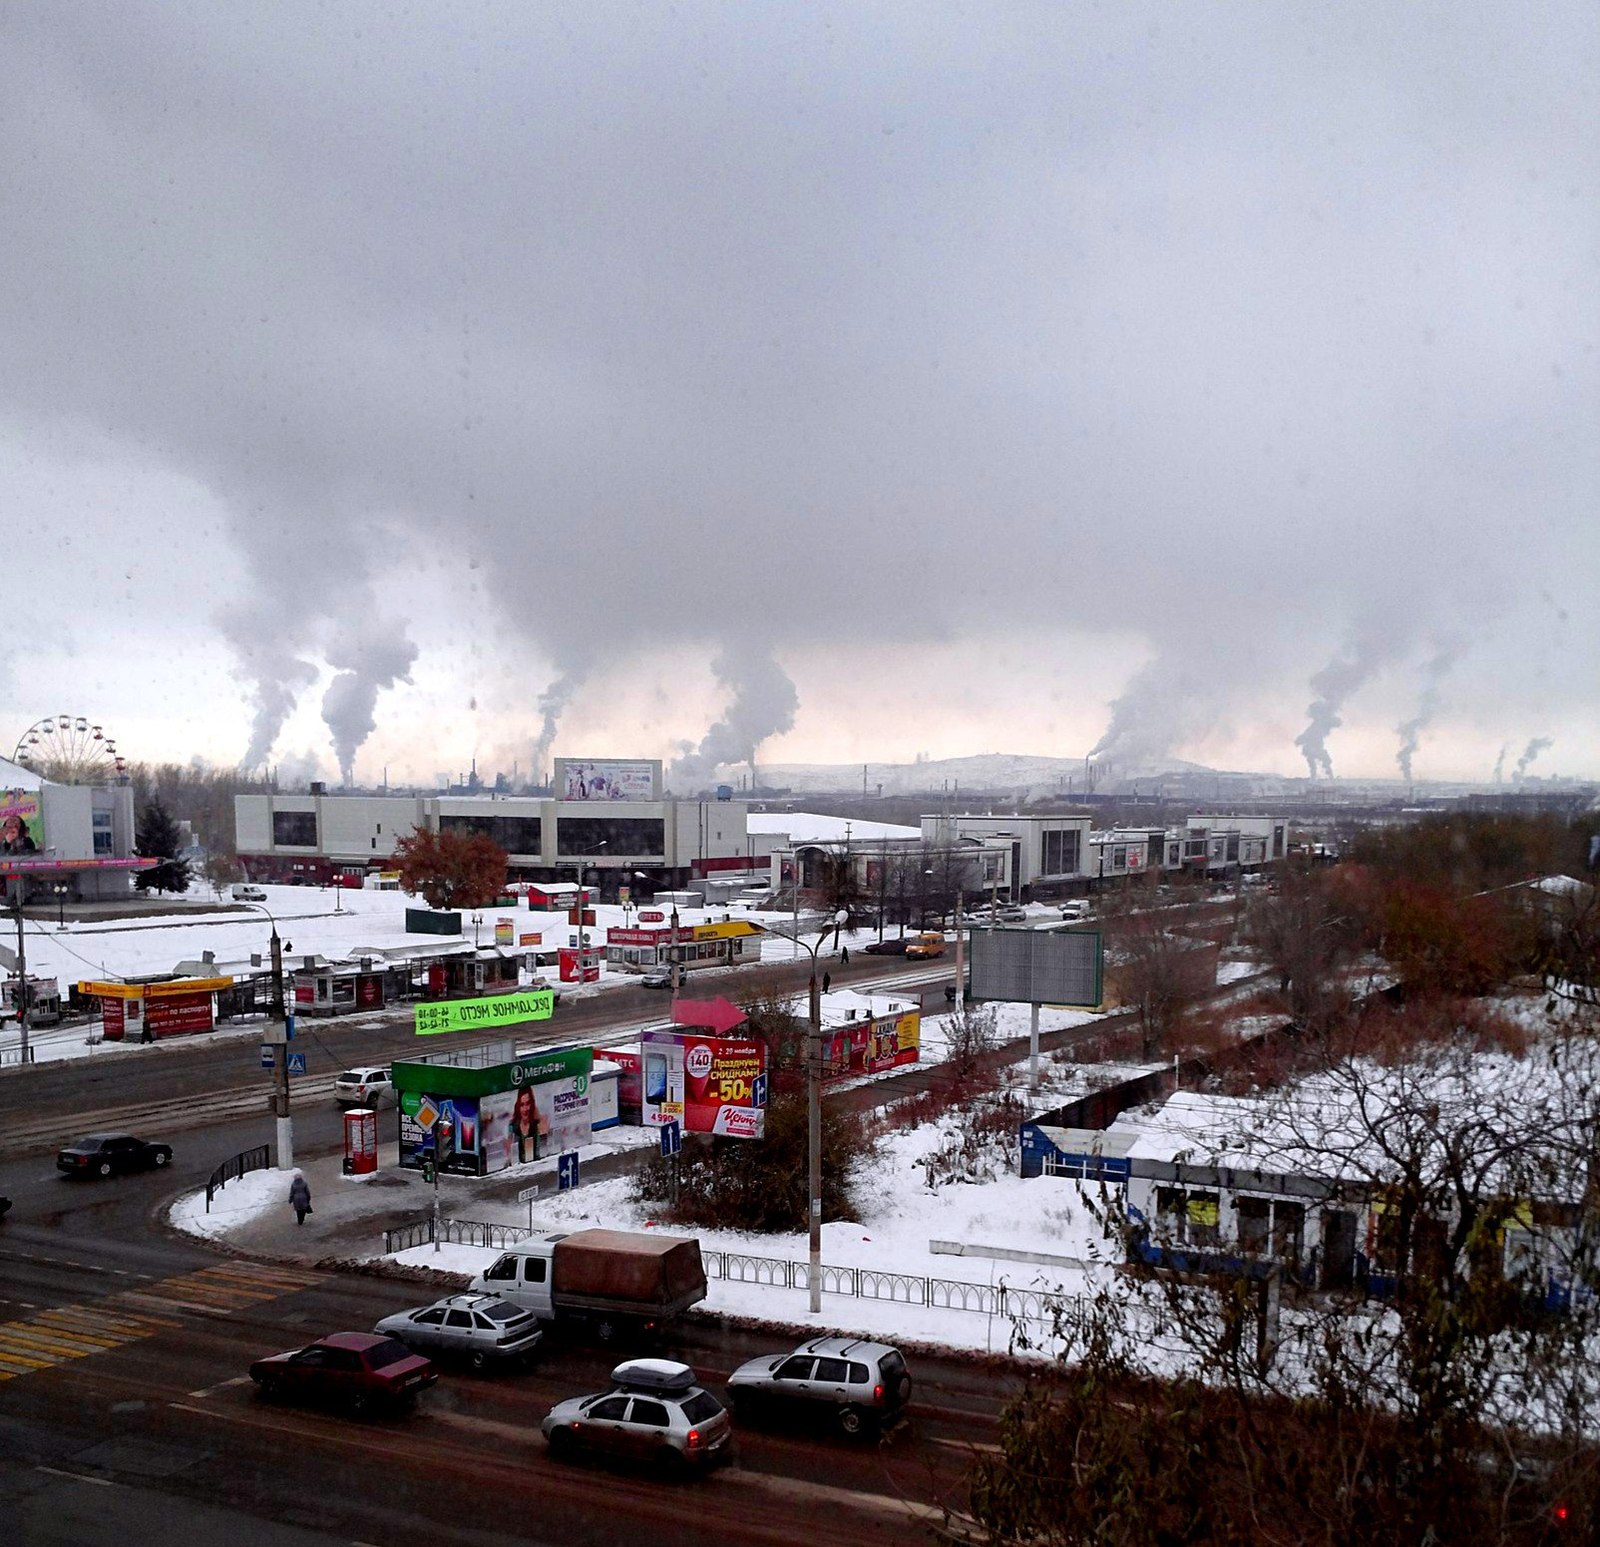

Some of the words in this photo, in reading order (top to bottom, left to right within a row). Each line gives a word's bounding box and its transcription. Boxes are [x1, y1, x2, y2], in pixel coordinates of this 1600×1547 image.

[639, 913, 664, 921] ЦВЕТЫ
[690, 1055, 709, 1066] 140
[401, 1132, 423, 1142] СЕЗОНА
